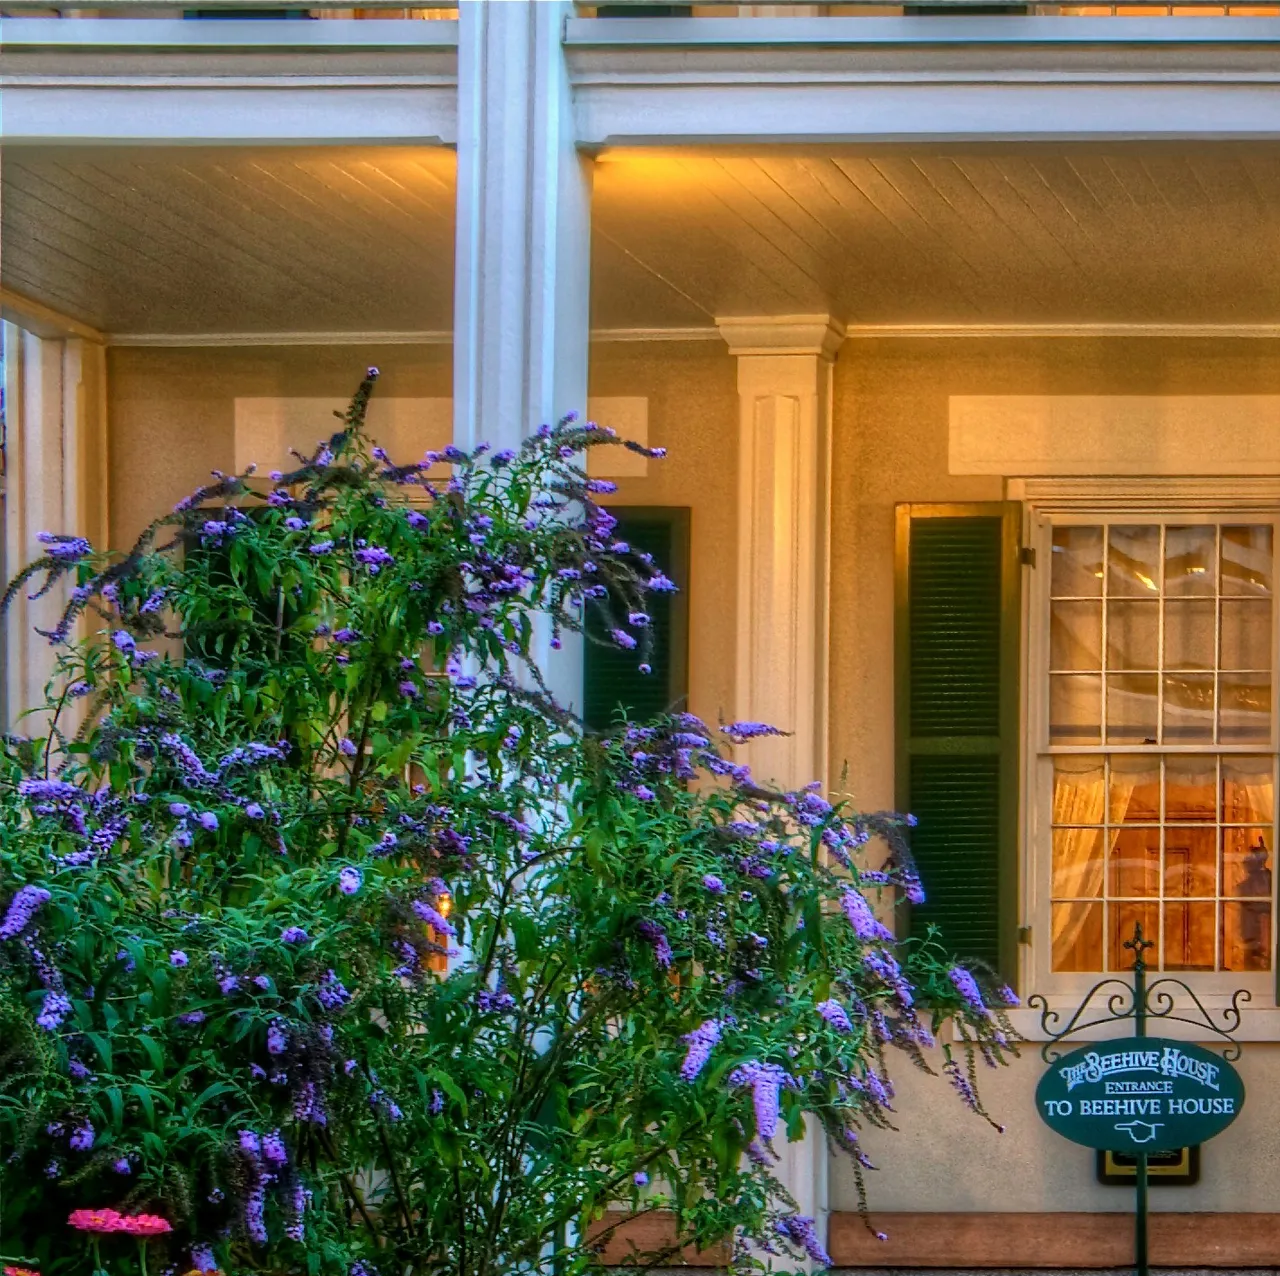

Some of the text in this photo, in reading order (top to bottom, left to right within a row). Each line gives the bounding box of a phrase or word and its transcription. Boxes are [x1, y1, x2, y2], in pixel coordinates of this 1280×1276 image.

[1084, 1051, 1160, 1083] BEEHIVE
[1160, 1047, 1219, 1091] HOUSE
[1104, 1081, 1173, 1094] ENTRANCE
[1044, 1098, 1234, 1116] TO BEEHIVE HOUSE
